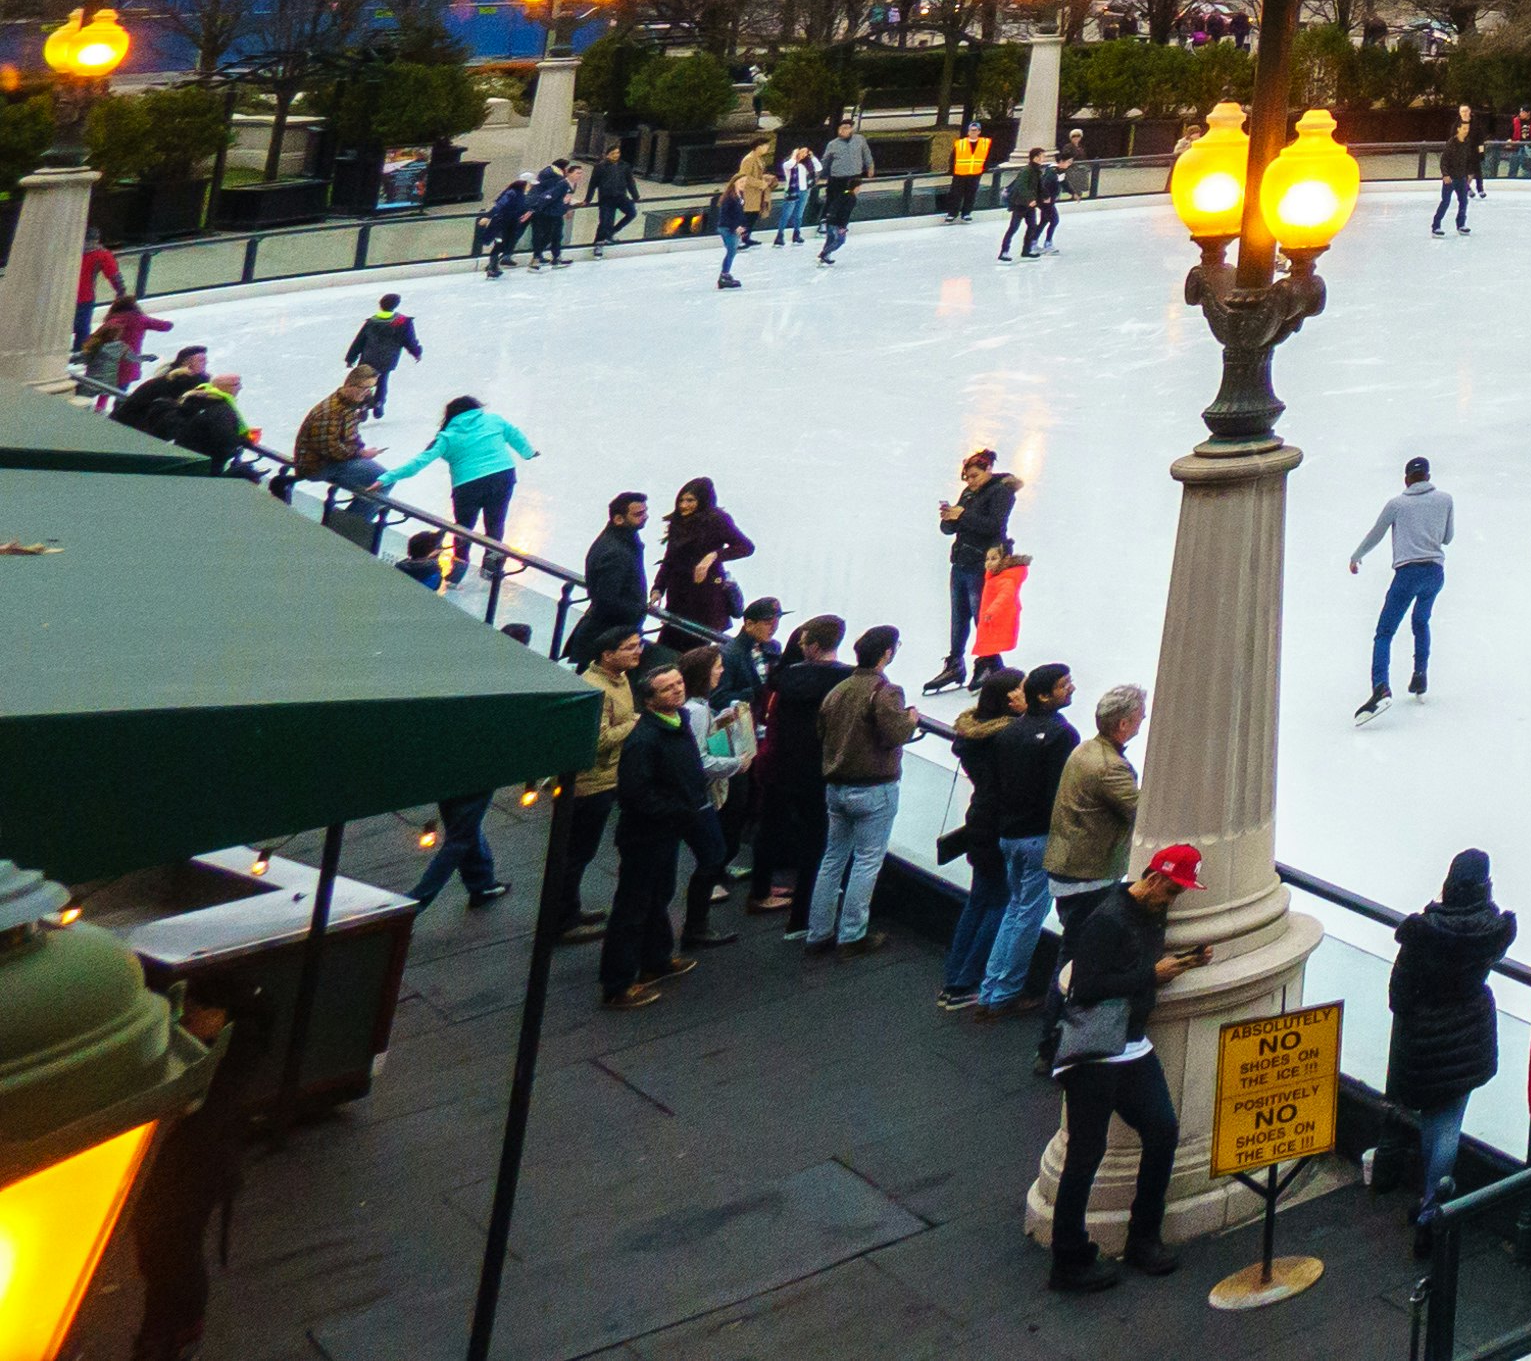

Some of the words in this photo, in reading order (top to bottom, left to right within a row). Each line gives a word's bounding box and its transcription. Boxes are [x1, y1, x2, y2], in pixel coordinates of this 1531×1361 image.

[1230, 1008, 1333, 1042] ABSOLUTELY
[1259, 1031, 1301, 1056] NO
[1240, 1054, 1290, 1075] SHOES
[1297, 1047, 1320, 1062] ON
[1240, 1073, 1269, 1089] THE
[1277, 1066, 1300, 1080] ICE
[1233, 1084, 1320, 1113] POSITIVELY
[1255, 1104, 1298, 1129] NO
[1236, 1127, 1286, 1149] SHOES
[1294, 1121, 1316, 1136] ON
[1235, 1147, 1265, 1165] THE
[1272, 1139, 1296, 1155] ICE
